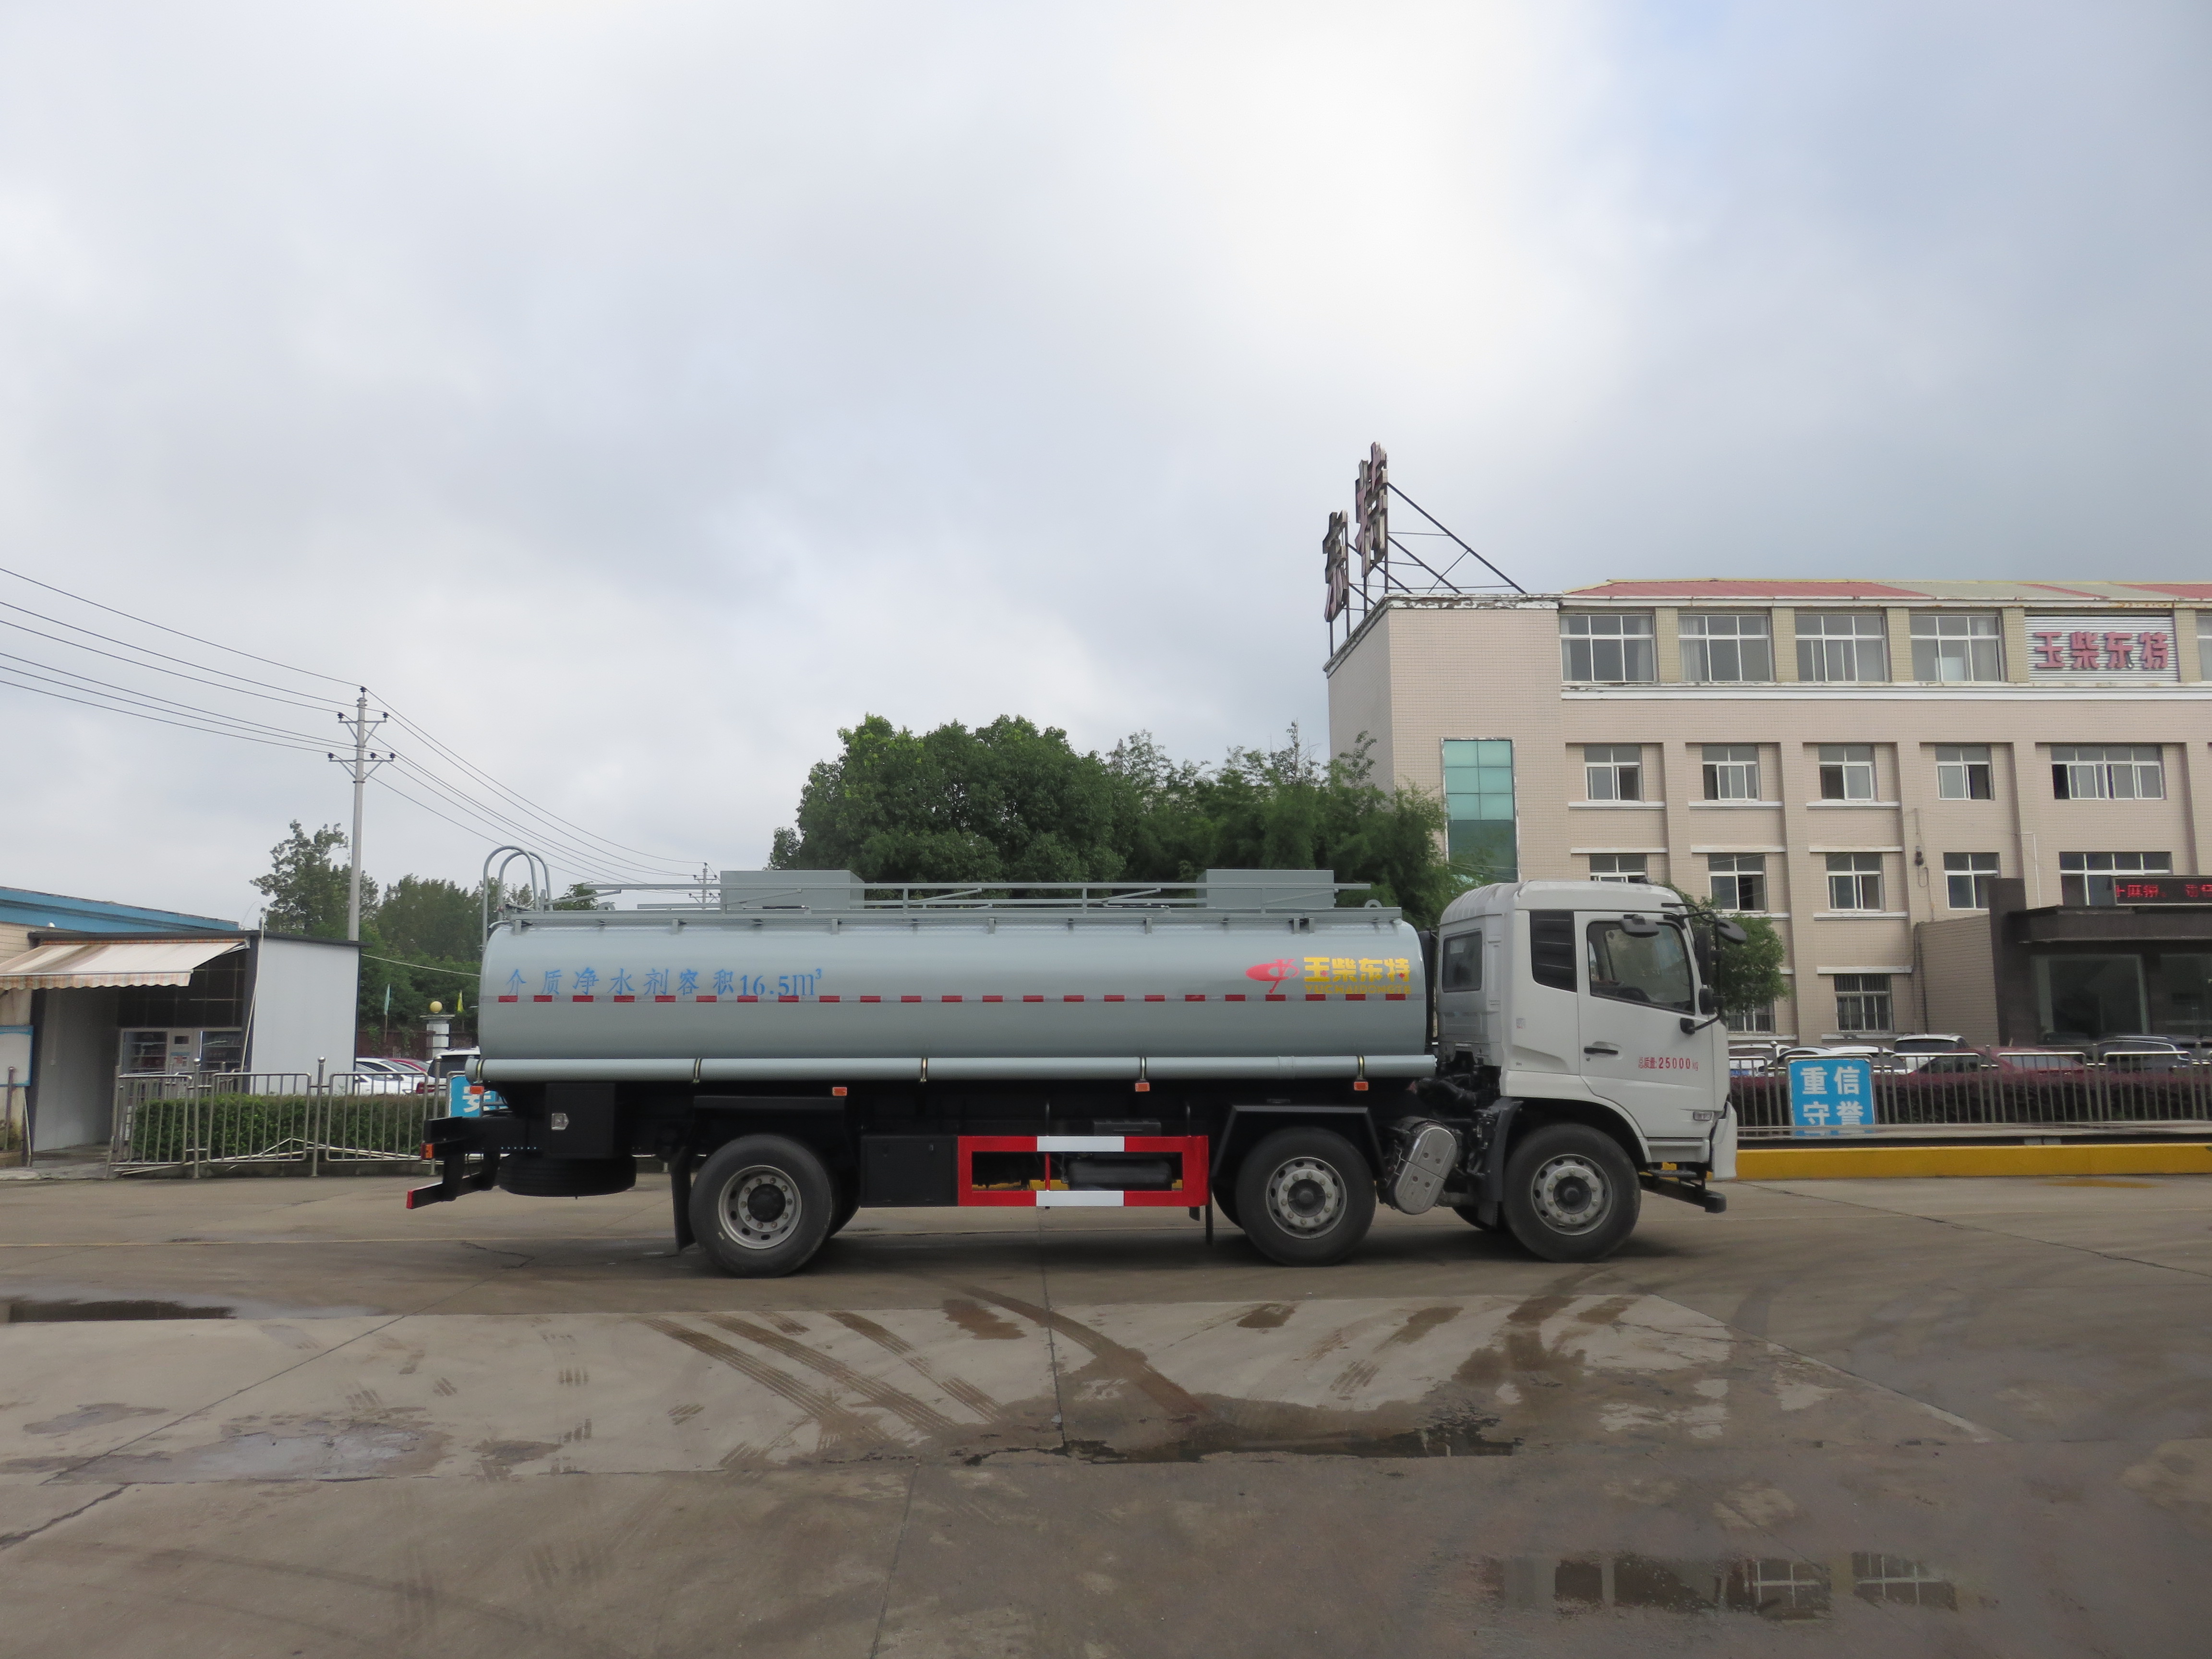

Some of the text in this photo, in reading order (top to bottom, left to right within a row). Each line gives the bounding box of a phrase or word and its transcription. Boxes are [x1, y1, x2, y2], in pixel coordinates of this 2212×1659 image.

[2034, 631, 2169, 669] 玉柴东特
[1304, 957, 1410, 983] 玉柴东特
